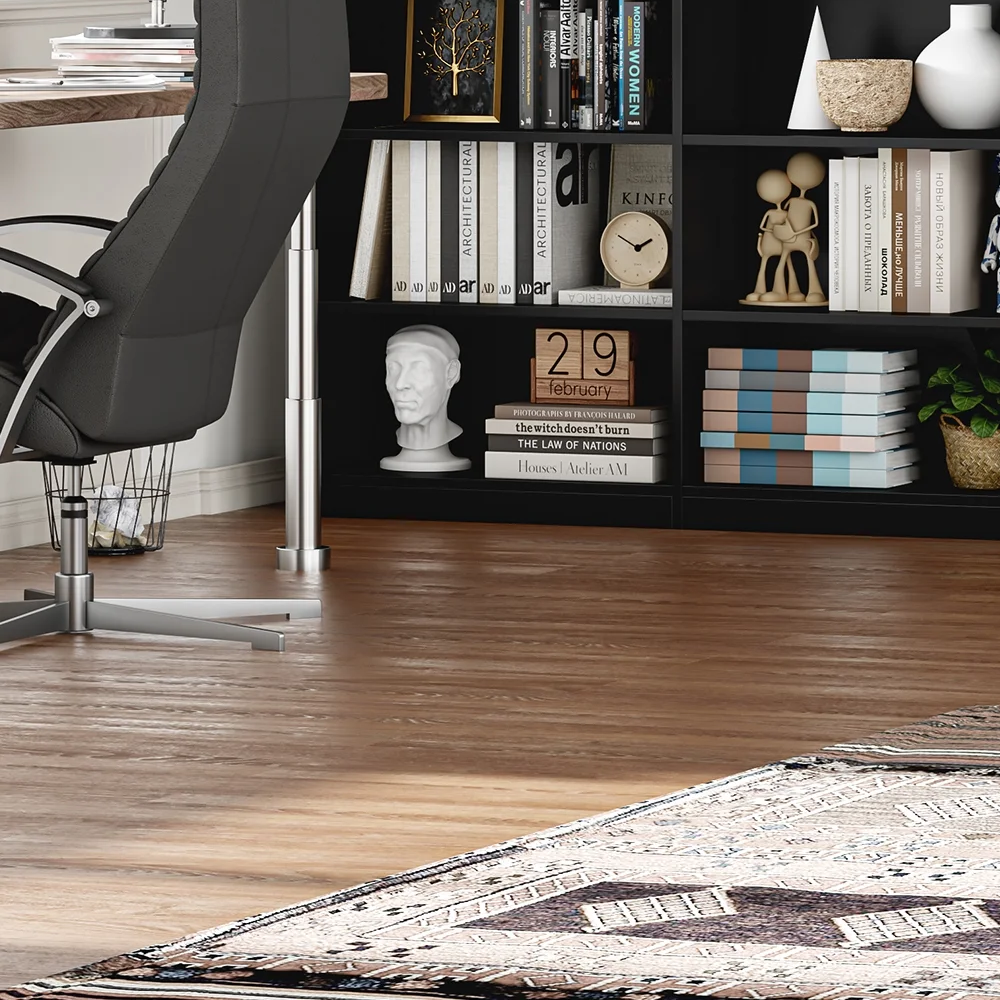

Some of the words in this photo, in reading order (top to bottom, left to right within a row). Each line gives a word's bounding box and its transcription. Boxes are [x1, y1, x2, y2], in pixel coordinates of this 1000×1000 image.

[561, 28, 571, 56] Alvar
[633, 6, 641, 47] MODERN
[629, 48, 640, 116] WOMEN
[462, 141, 472, 257] ARCHITECTURAL
[537, 142, 546, 258] ARCHITECTURAL
[864, 184, 872, 220] ЗАБОТА
[935, 172, 945, 212] НОВЫЙ
[935, 215, 944, 250] ОБРАЗ
[863, 232, 872, 292] ПРЕДАННЫХ
[935, 253, 944, 293] ЖИЗНИ
[459, 279, 476, 294] ar
[534, 281, 551, 295] ar
[548, 379, 612, 400] february
[513, 409, 563, 418] PHOTOGRAPHS
[564, 410, 573, 418] BY
[573, 411, 607, 421] FRANÇOIS
[608, 412, 636, 420] HALARD
[515, 422, 533, 432] the
[534, 422, 564, 433] witch
[605, 424, 630, 435] burn
[518, 438, 538, 448] THE
[541, 439, 562, 449] LAW
[565, 440, 579, 450] OF
[582, 441, 627, 451] NATIONS
[518, 459, 557, 474] Houses
[567, 461, 604, 475] Atelier
[604, 462, 628, 476] AM
